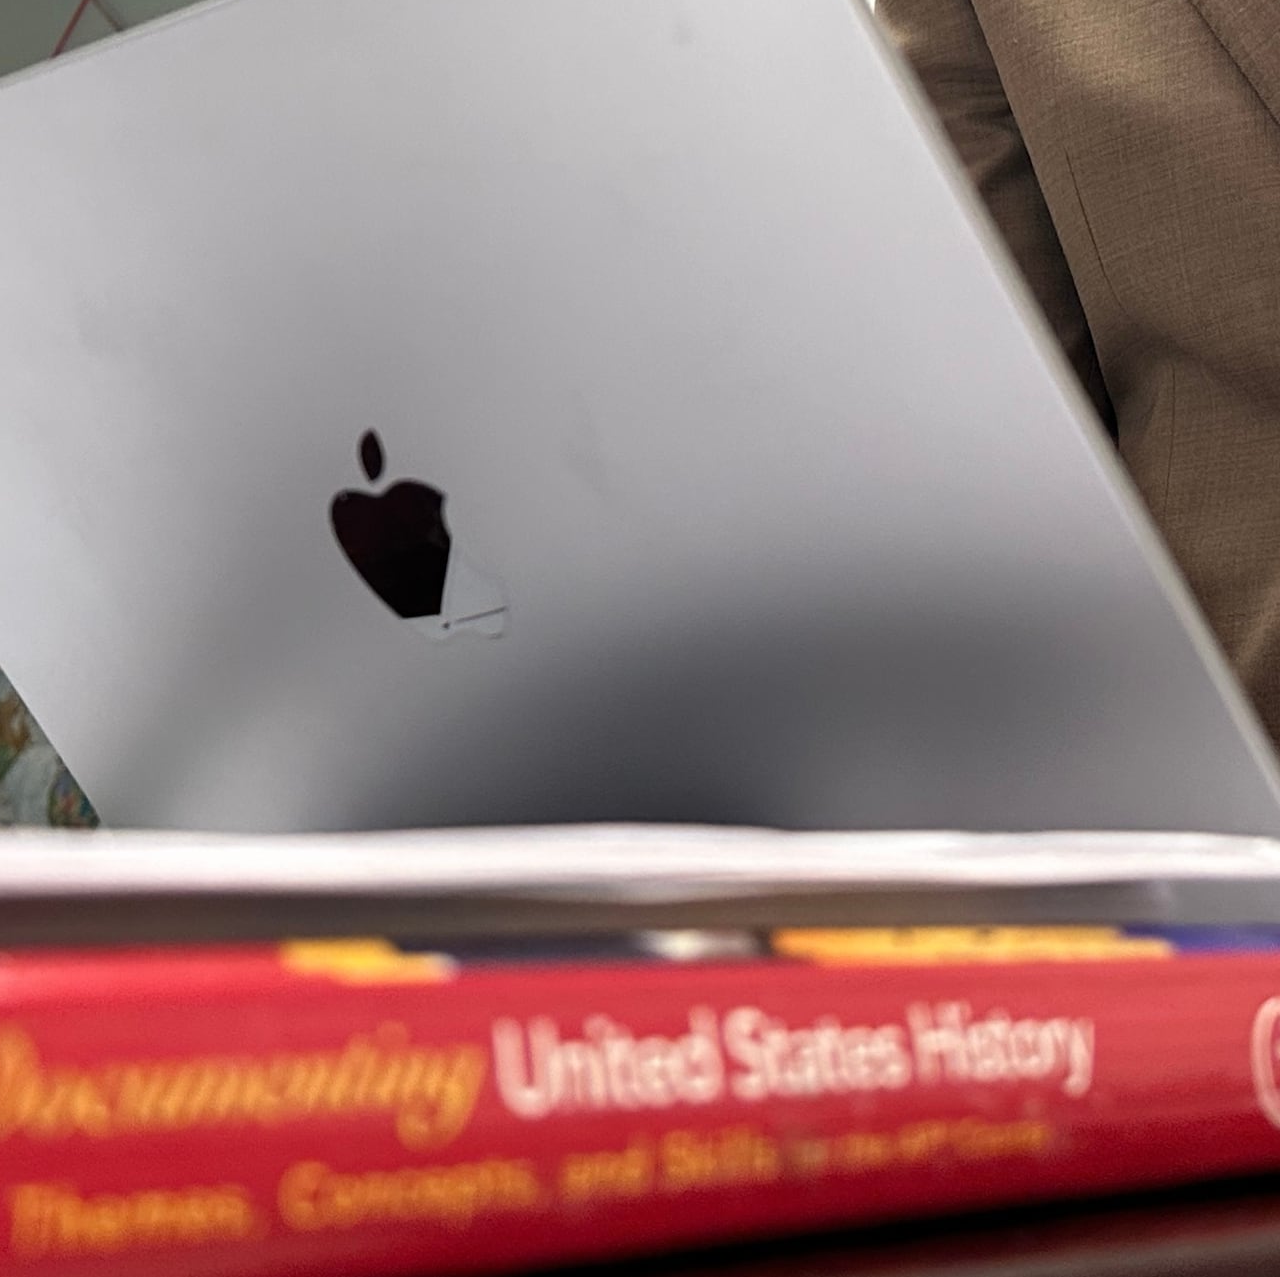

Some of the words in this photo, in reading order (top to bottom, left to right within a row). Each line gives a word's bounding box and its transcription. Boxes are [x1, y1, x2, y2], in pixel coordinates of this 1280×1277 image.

[492, 1008, 723, 1118] United
[723, 1006, 912, 1100] States
[908, 1000, 1096, 1098] History
